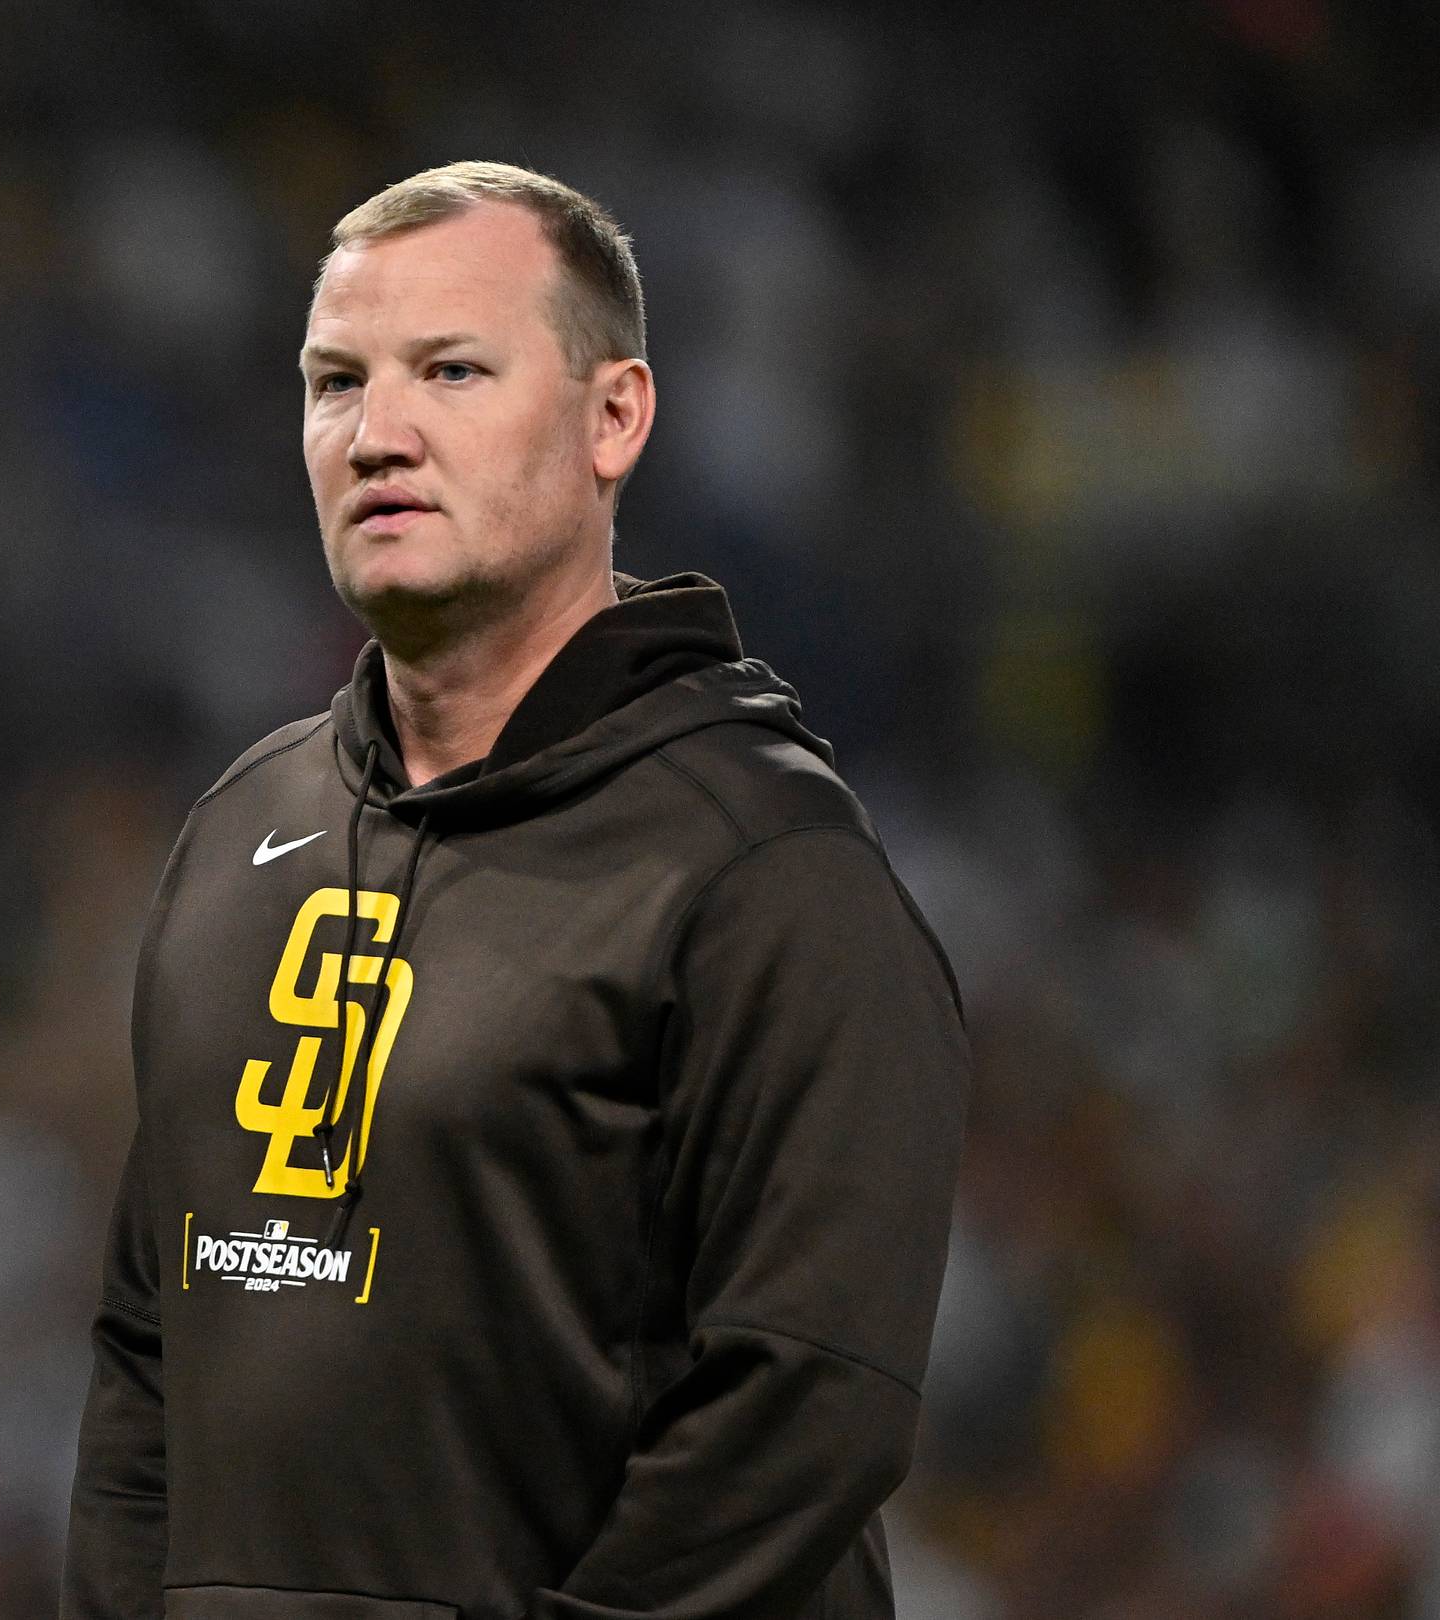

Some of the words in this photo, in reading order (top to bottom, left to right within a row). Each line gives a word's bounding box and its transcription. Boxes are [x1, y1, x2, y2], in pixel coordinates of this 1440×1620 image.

[235, 887, 414, 1199] SD
[195, 1235, 352, 1282] POSTSEASON
[244, 1277, 280, 1292] 2024
